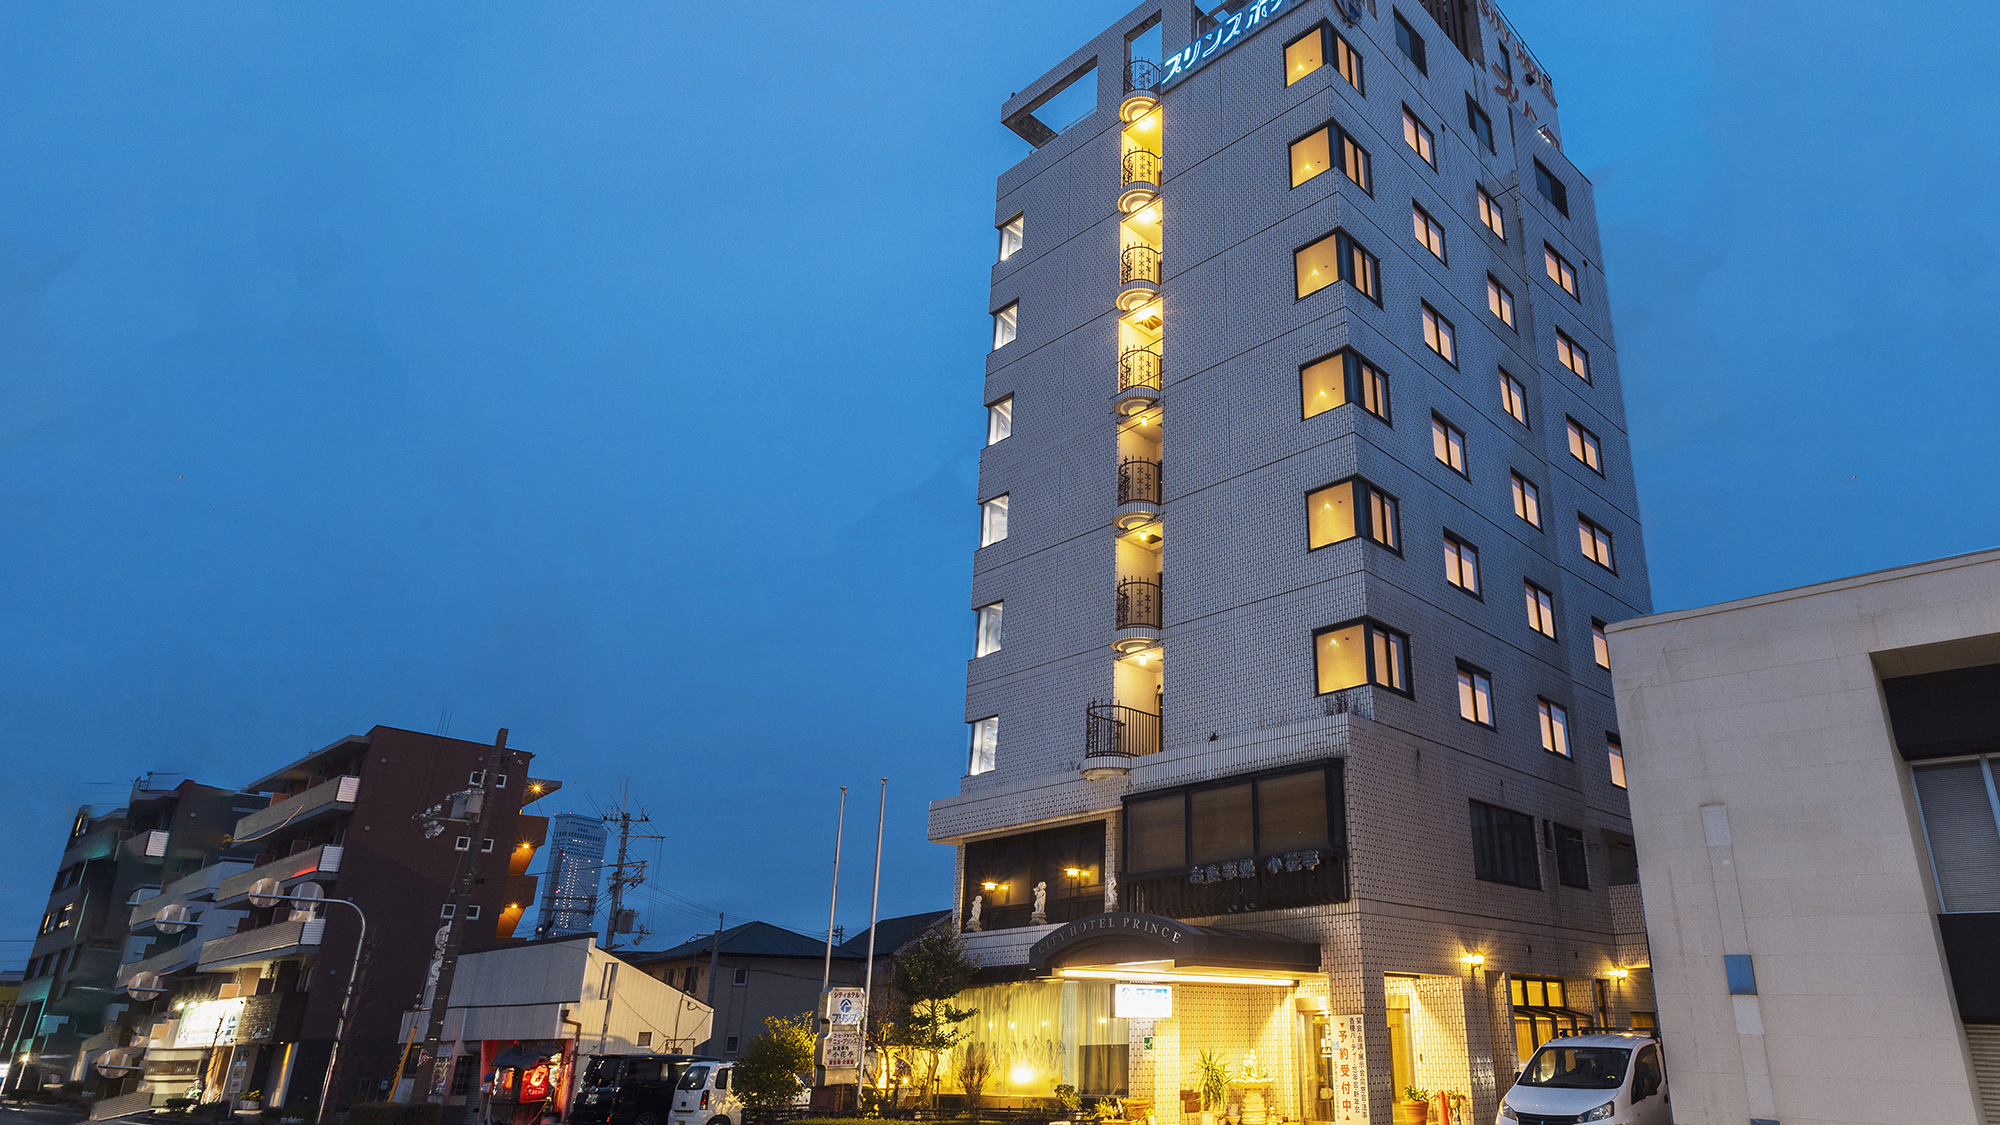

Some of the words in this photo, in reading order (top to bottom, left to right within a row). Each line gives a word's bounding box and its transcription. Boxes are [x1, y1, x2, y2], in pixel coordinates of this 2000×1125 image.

[1161, 0, 1283, 85] プリンスホ
[1038, 931, 1067, 955] CITY
[1069, 917, 1116, 937] HOTEL
[1122, 917, 1182, 944] PRINCE
[833, 991, 861, 999] シティホテル
[1338, 1030, 1352, 1113] 予約受付中
